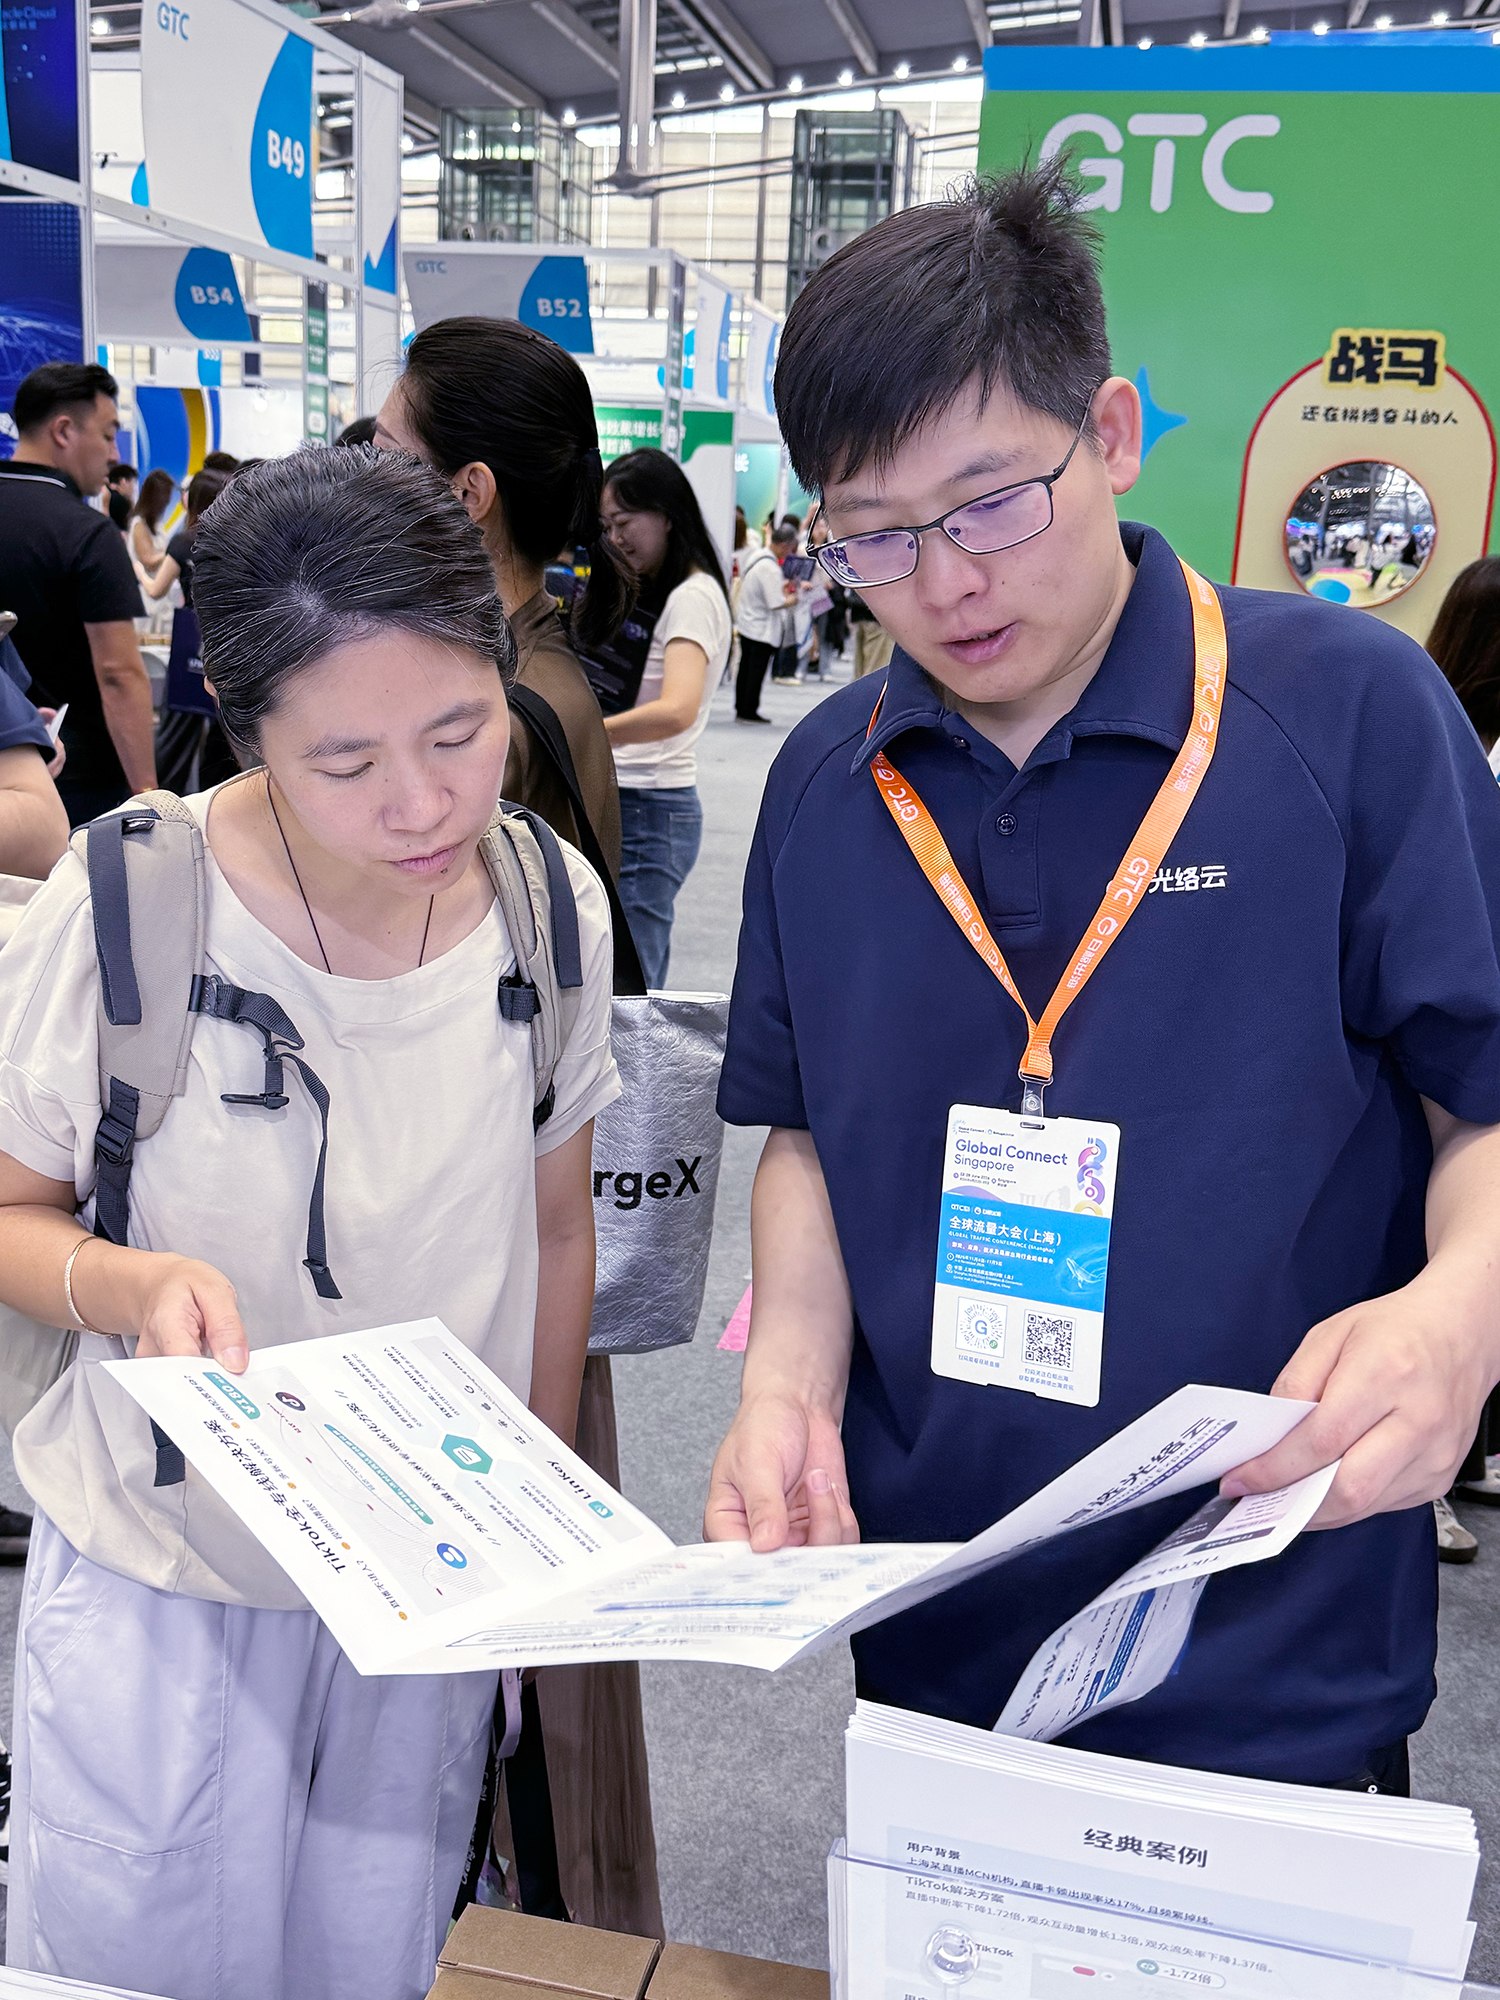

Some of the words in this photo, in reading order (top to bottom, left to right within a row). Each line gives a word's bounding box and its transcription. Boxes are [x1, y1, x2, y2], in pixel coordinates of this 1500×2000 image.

[157, 2, 190, 41] GTC
[267, 129, 305, 179] B49
[1040, 113, 1281, 214] GTC
[416, 260, 447, 274] GTC
[190, 285, 234, 305] B54
[537, 298, 583, 318] B52
[1328, 333, 1441, 387] 战马
[1302, 405, 1459, 424] 还在拼搏奋斗的人
[1202, 656, 1221, 702] GTC
[888, 787, 919, 822] GTC
[1114, 857, 1150, 906] GTC
[1066, 938, 1104, 989] 白鲸出海
[953, 1153, 1015, 1175] Singapore
[955, 1137, 1002, 1157] Global
[1004, 1144, 1068, 1166] Connect
[969, 1234, 991, 1242] TRAFFIC
[991, 1237, 1027, 1249] CONFERENCE
[973, 1318, 988, 1335] G
[543, 1459, 593, 1500] LinKey
[201, 1418, 351, 1574] TikTok全专线解决方案
[906, 1841, 961, 1861] 用户背景
[1083, 1829, 1208, 1868] 经典案例
[905, 1877, 1004, 1904] TikTok解决方案
[975, 1942, 1013, 1958] TikTok
[1164, 1967, 1212, 1984] -1.72倍
